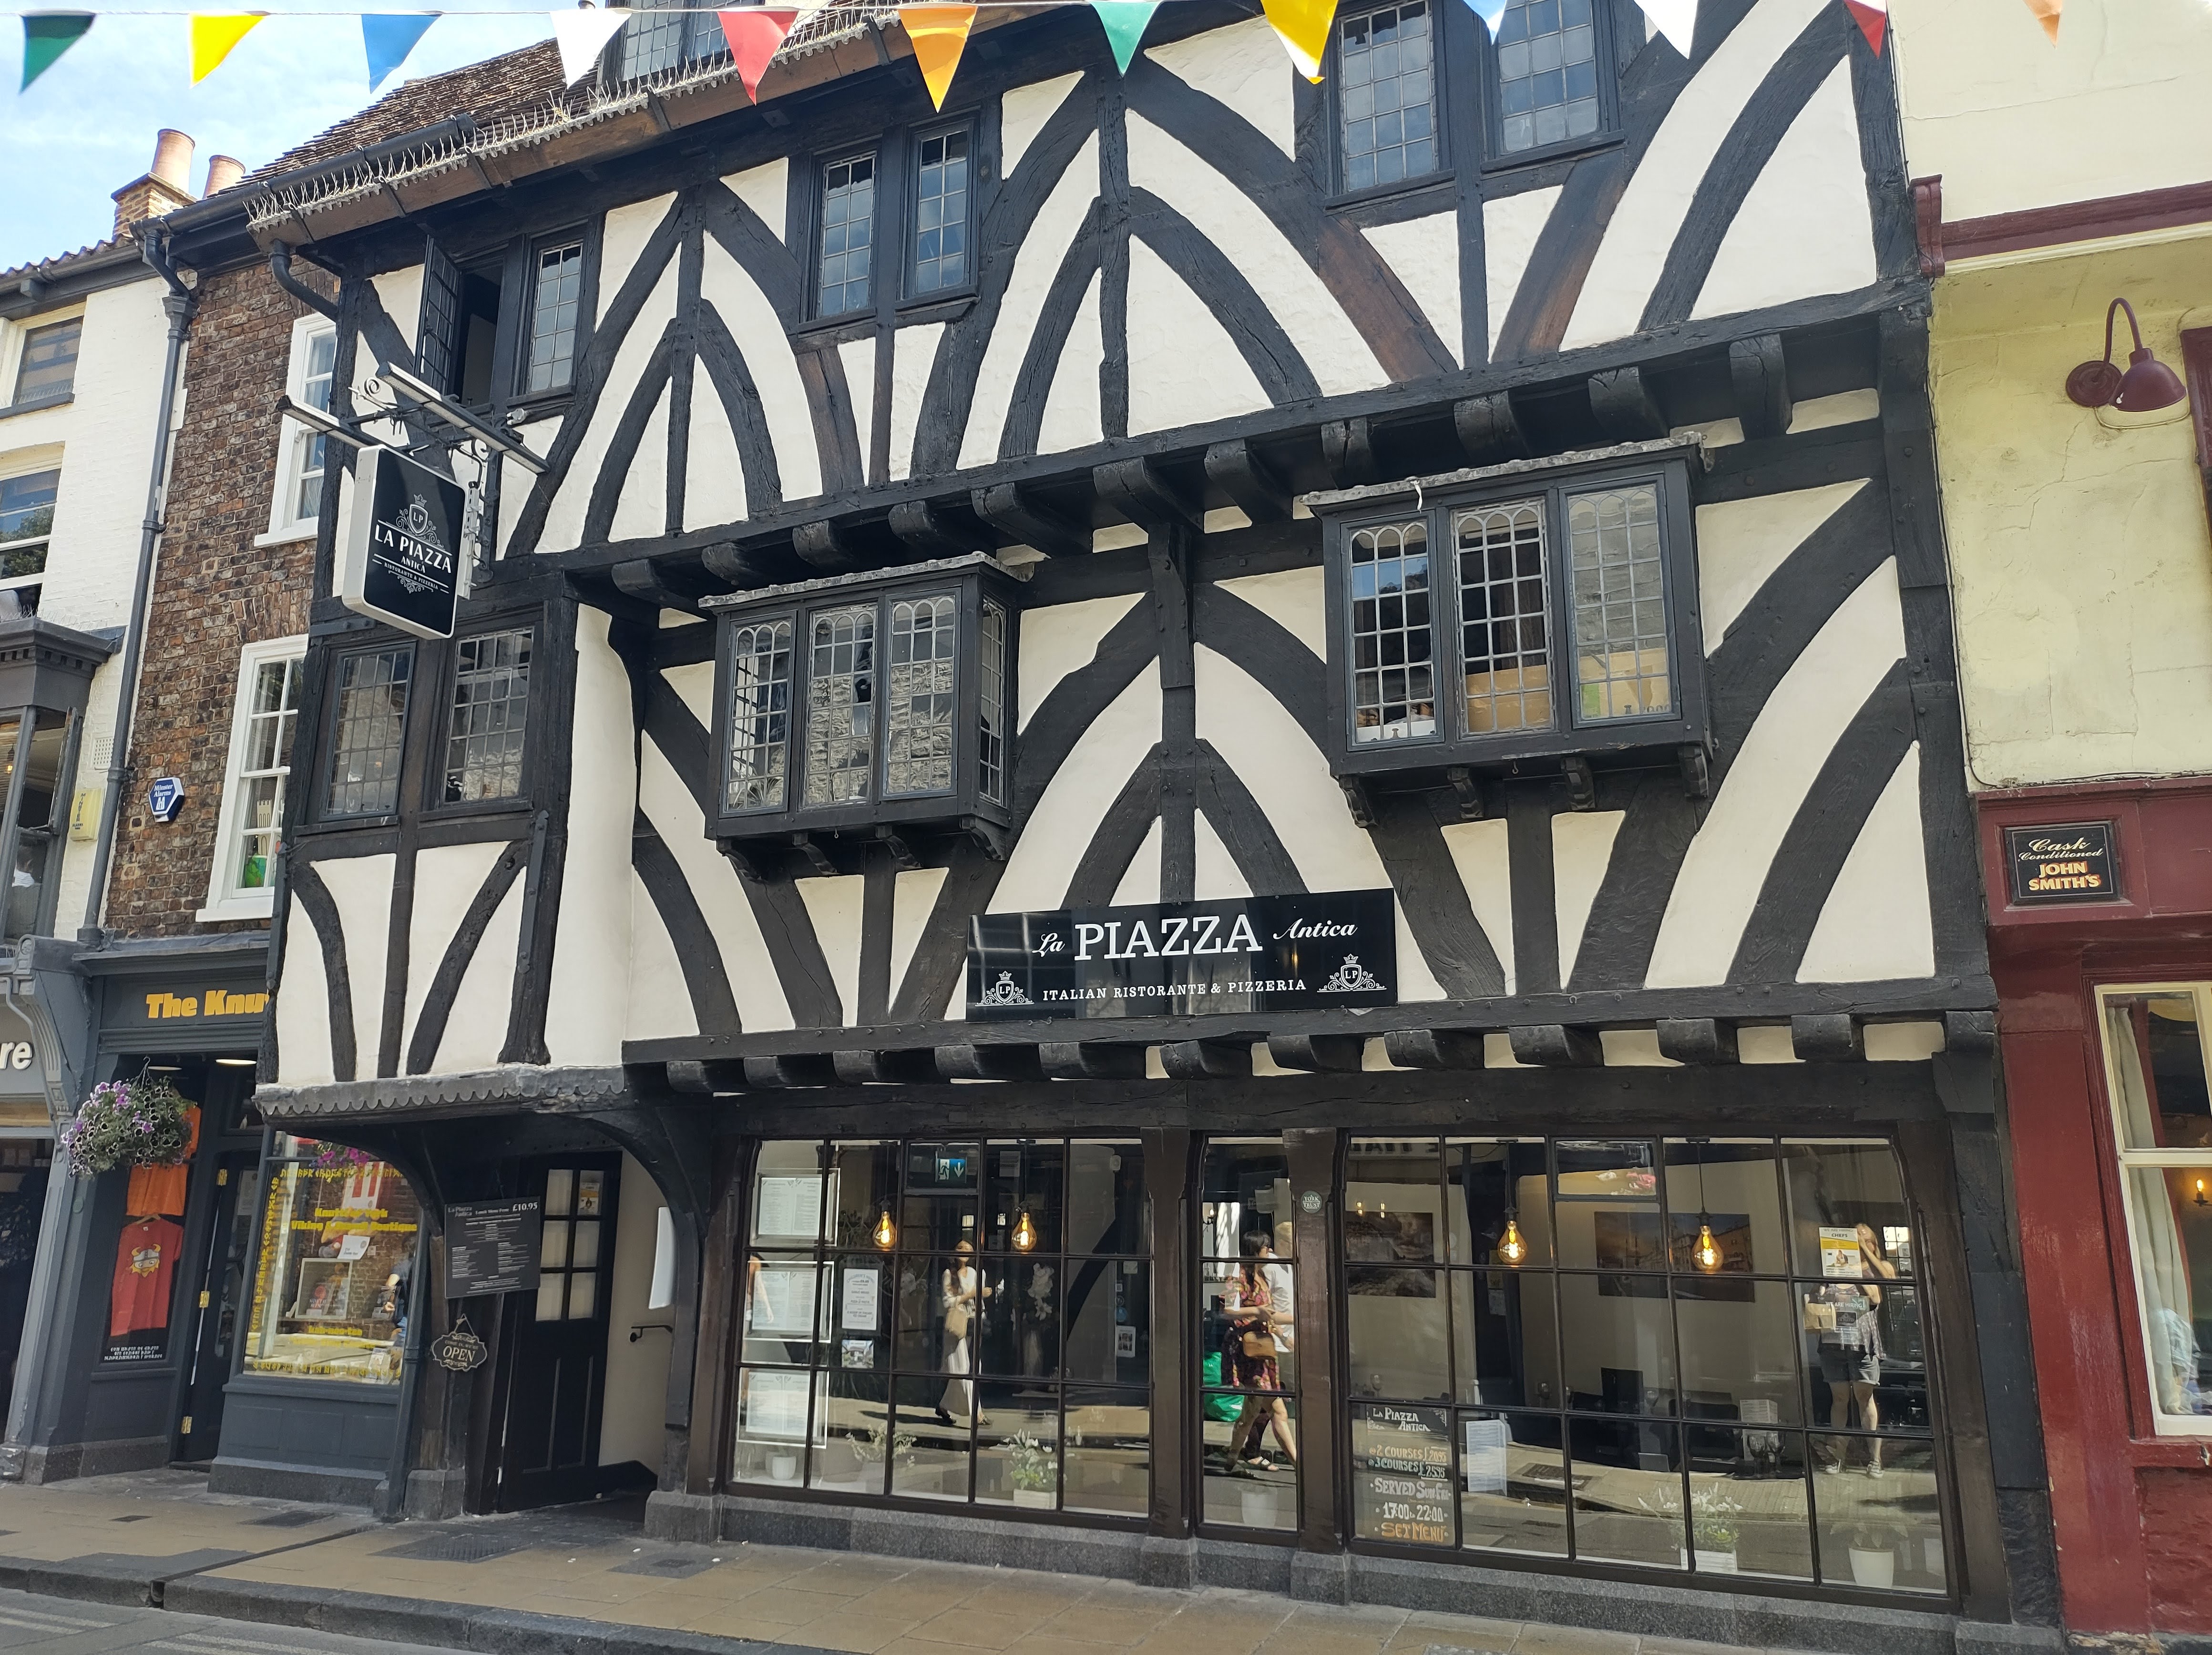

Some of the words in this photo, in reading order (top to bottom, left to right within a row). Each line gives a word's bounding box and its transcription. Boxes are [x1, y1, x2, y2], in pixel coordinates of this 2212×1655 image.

[413, 512, 423, 523] LP
[375, 524, 394, 547] LA
[399, 535, 451, 573] PIAZZA
[401, 555, 425, 573] ANTICA
[384, 562, 413, 579] RISTORANTE
[418, 578, 439, 590] PIZZERIA
[2028, 837, 2091, 852] Cask
[2018, 848, 2104, 861] Conditioned
[2038, 860, 2088, 879] JOHN
[2028, 874, 2101, 891] SMITH'S
[1032, 932, 1065, 957] La
[1074, 914, 1263, 961] PIAZZA
[1273, 918, 1358, 940] Antica
[1345, 971, 1358, 979] LP
[999, 986, 1011, 994] LP
[1043, 988, 1106, 1001] ITALIAN
[1113, 983, 1206, 998] RISTORANTE
[1210, 983, 1221, 994] &
[1228, 979, 1306, 993] PIZZERIA
[146, 992, 197, 1019] The
[512, 1202, 538, 1212] £10.95
[291, 1220, 324, 1231] Viking
[443, 1346, 476, 1362] OPEN
[1384, 1407, 1419, 1422] PIAZZA
[1398, 1421, 1431, 1431] ANTICA
[1377, 1444, 1382, 1457] 2
[1384, 1446, 1423, 1460] COURSES
[1381, 1458, 1419, 1472] COURSES
[1374, 1477, 1415, 1496] SERVED
[1383, 1502, 1410, 1520] 17:00
[1416, 1504, 1444, 1522] 22:00
[1381, 1522, 1411, 1538] SET
[1412, 1522, 1446, 1543] MENU
